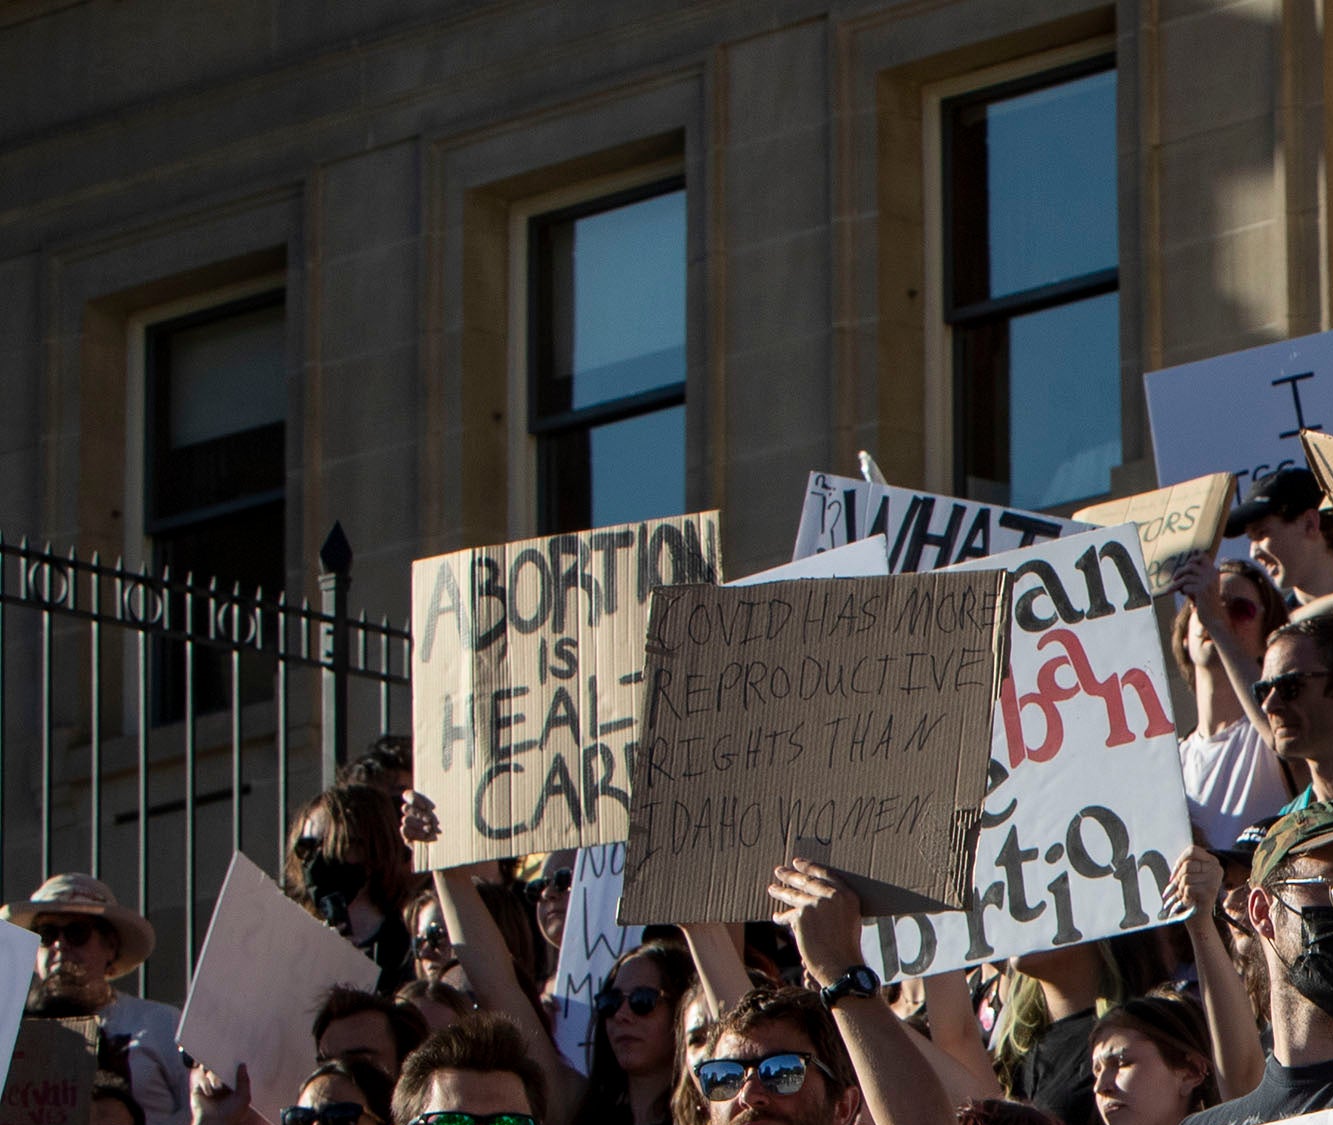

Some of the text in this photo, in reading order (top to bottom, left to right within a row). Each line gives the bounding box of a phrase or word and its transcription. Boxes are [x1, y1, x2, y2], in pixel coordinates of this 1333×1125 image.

[421, 519, 723, 663] ABORTION
[657, 584, 1001, 653] COVID HAS MORE
[540, 636, 579, 686] IS
[648, 648, 987, 730] REPRODUCTIVE
[647, 710, 947, 788] RIGHTS THAN
[636, 798, 763, 872] IDAHO
[779, 791, 934, 846] WOMEN
